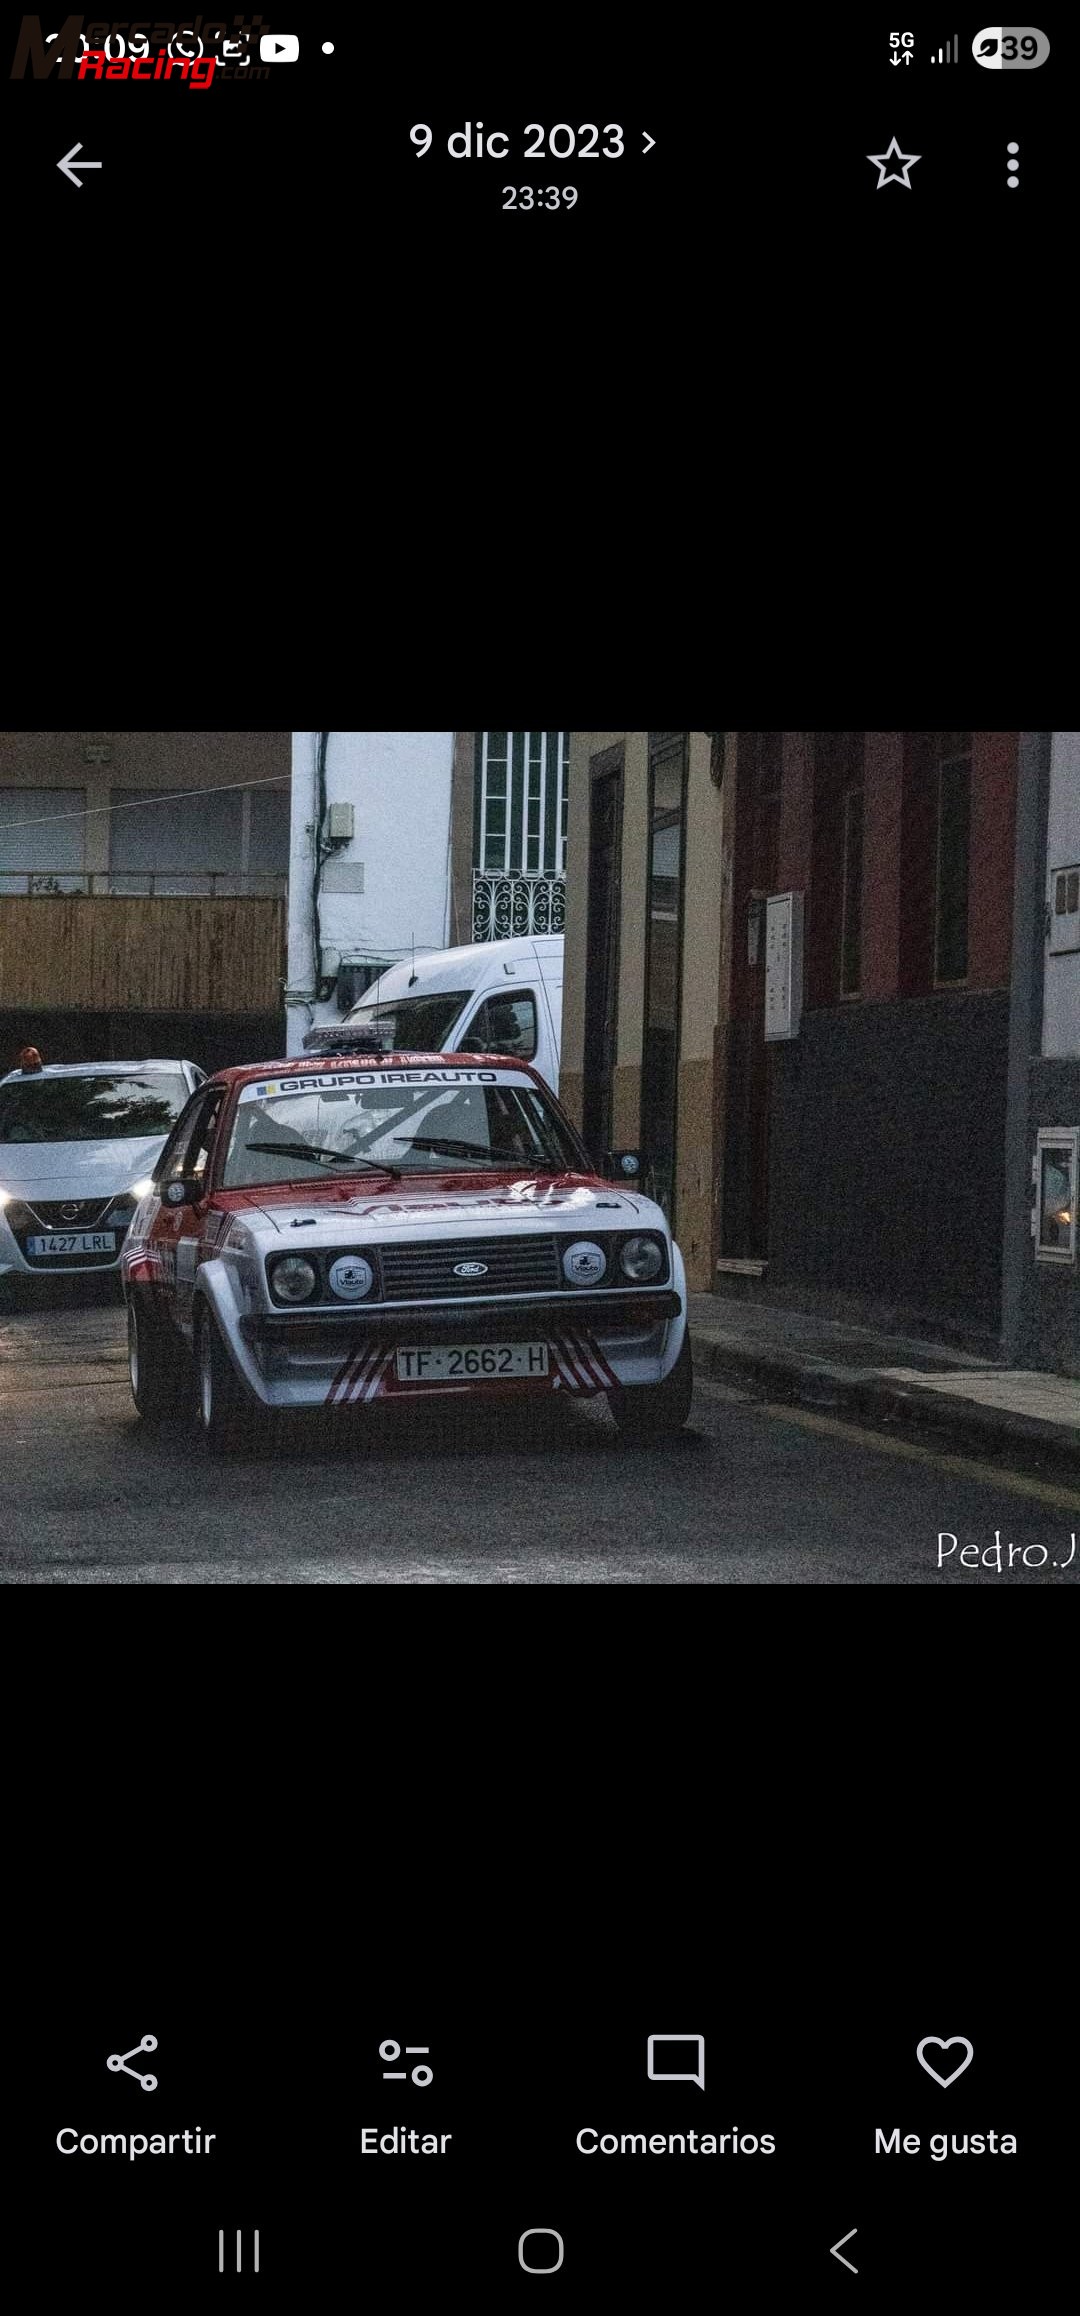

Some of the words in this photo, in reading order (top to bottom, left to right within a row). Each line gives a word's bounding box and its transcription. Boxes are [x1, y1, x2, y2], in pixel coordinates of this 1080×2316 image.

[888, 31, 915, 49] 5G
[1000, 35, 1039, 61] 39
[409, 123, 433, 159] 9
[447, 121, 510, 159] dic
[523, 123, 625, 159] 2023
[502, 185, 579, 211] 23:39
[280, 1073, 375, 1093] GRUPO
[380, 1070, 498, 1086] IREAUTO
[40, 1236, 77, 1252] 1427
[82, 1234, 112, 1250] LRL
[56, 2125, 217, 2162] Compartir
[361, 2126, 453, 2155] Editar
[576, 2125, 776, 2155] Comentarios
[875, 2127, 921, 2155] Me
[929, 2128, 1017, 2162] gusta
